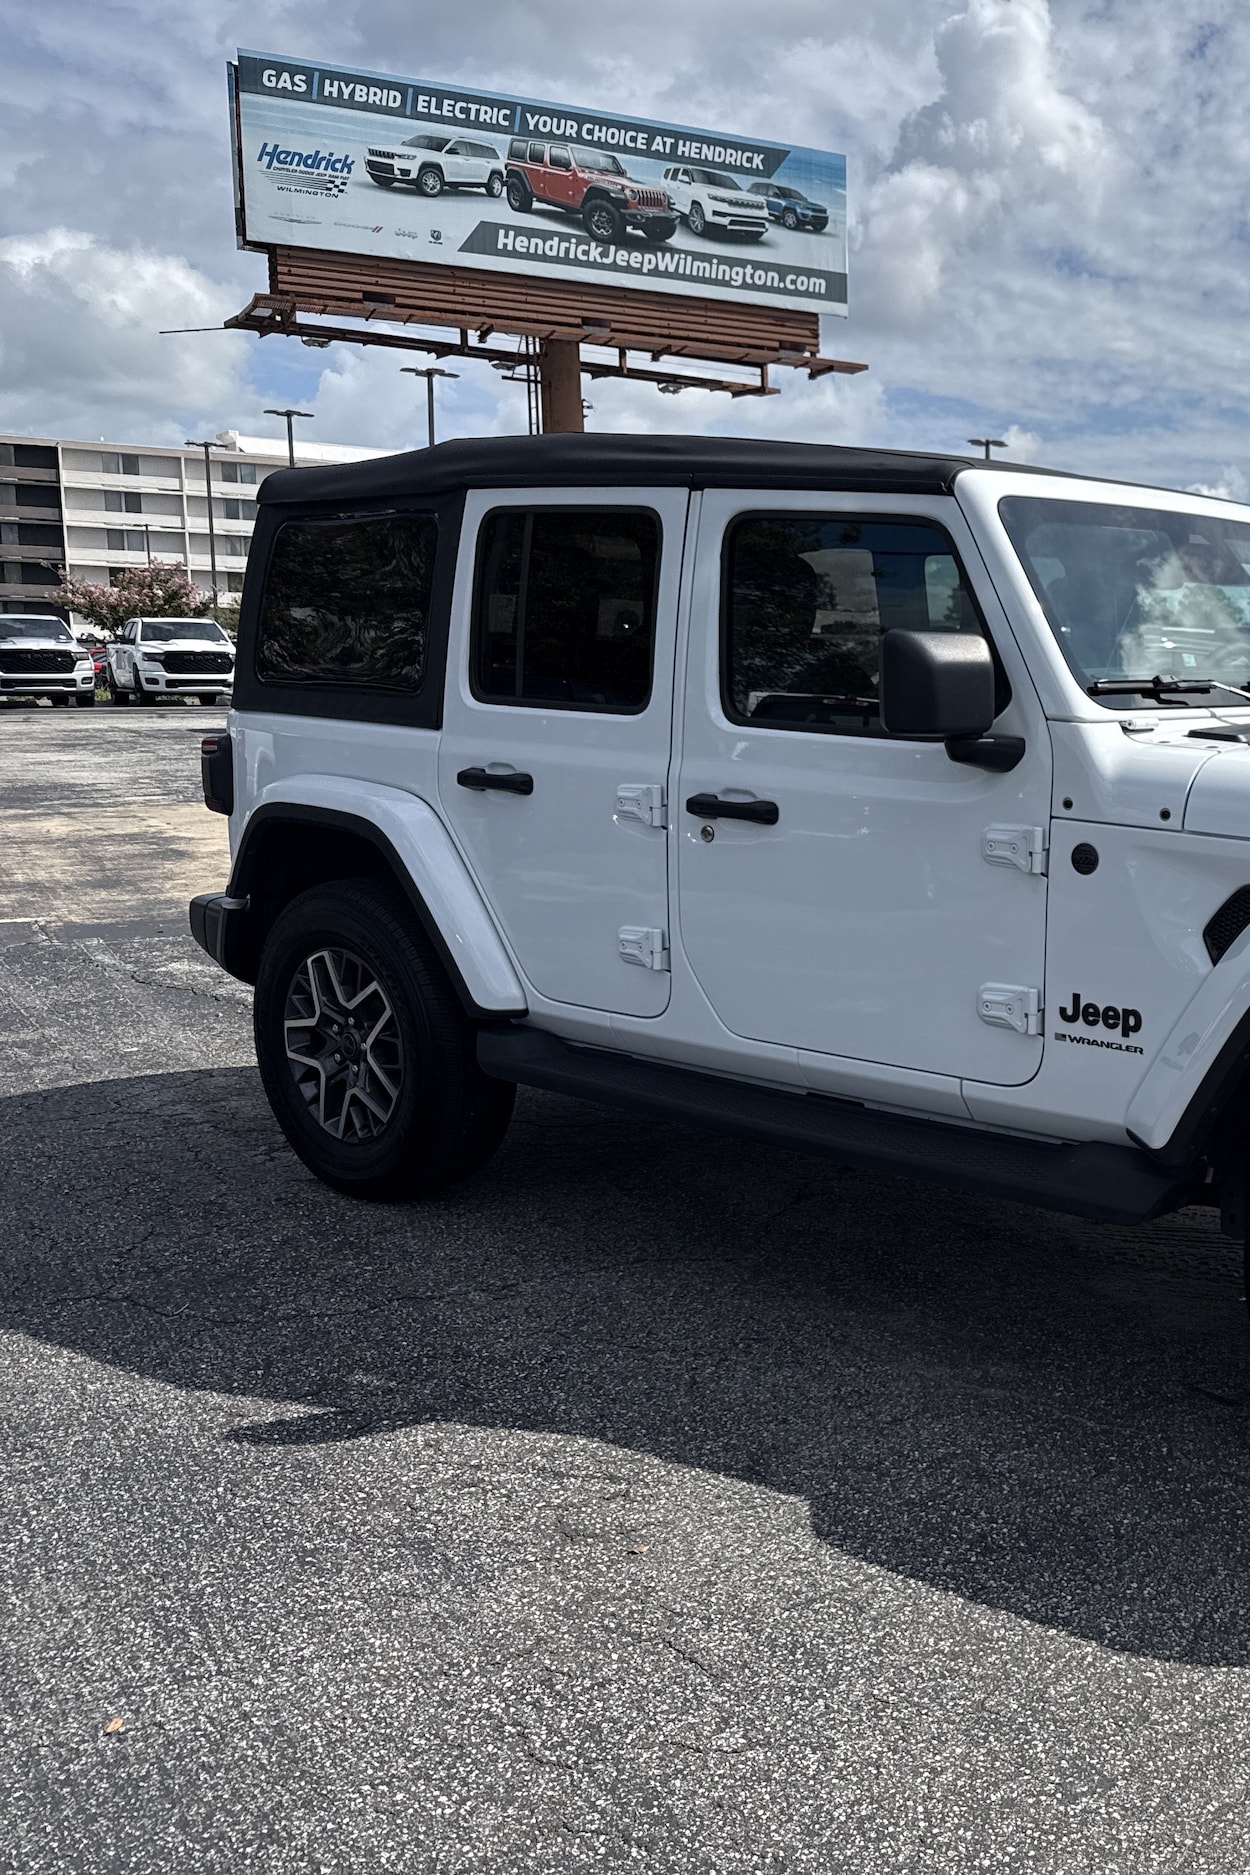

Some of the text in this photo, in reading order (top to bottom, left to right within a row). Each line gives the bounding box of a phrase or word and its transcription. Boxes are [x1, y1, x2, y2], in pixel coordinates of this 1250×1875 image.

[262, 69, 765, 170] GAS HYBRID ELECTRIC YOUR CHOICE AT HENDRICK
[257, 142, 356, 175] Hendrick
[298, 169, 315, 177] DODGE
[277, 186, 339, 199] WILMINGTON
[497, 229, 827, 295] HendrickJeepWilmington.com
[1059, 992, 1143, 1038] Jeep
[1068, 1034, 1144, 1055] WRANGLER
